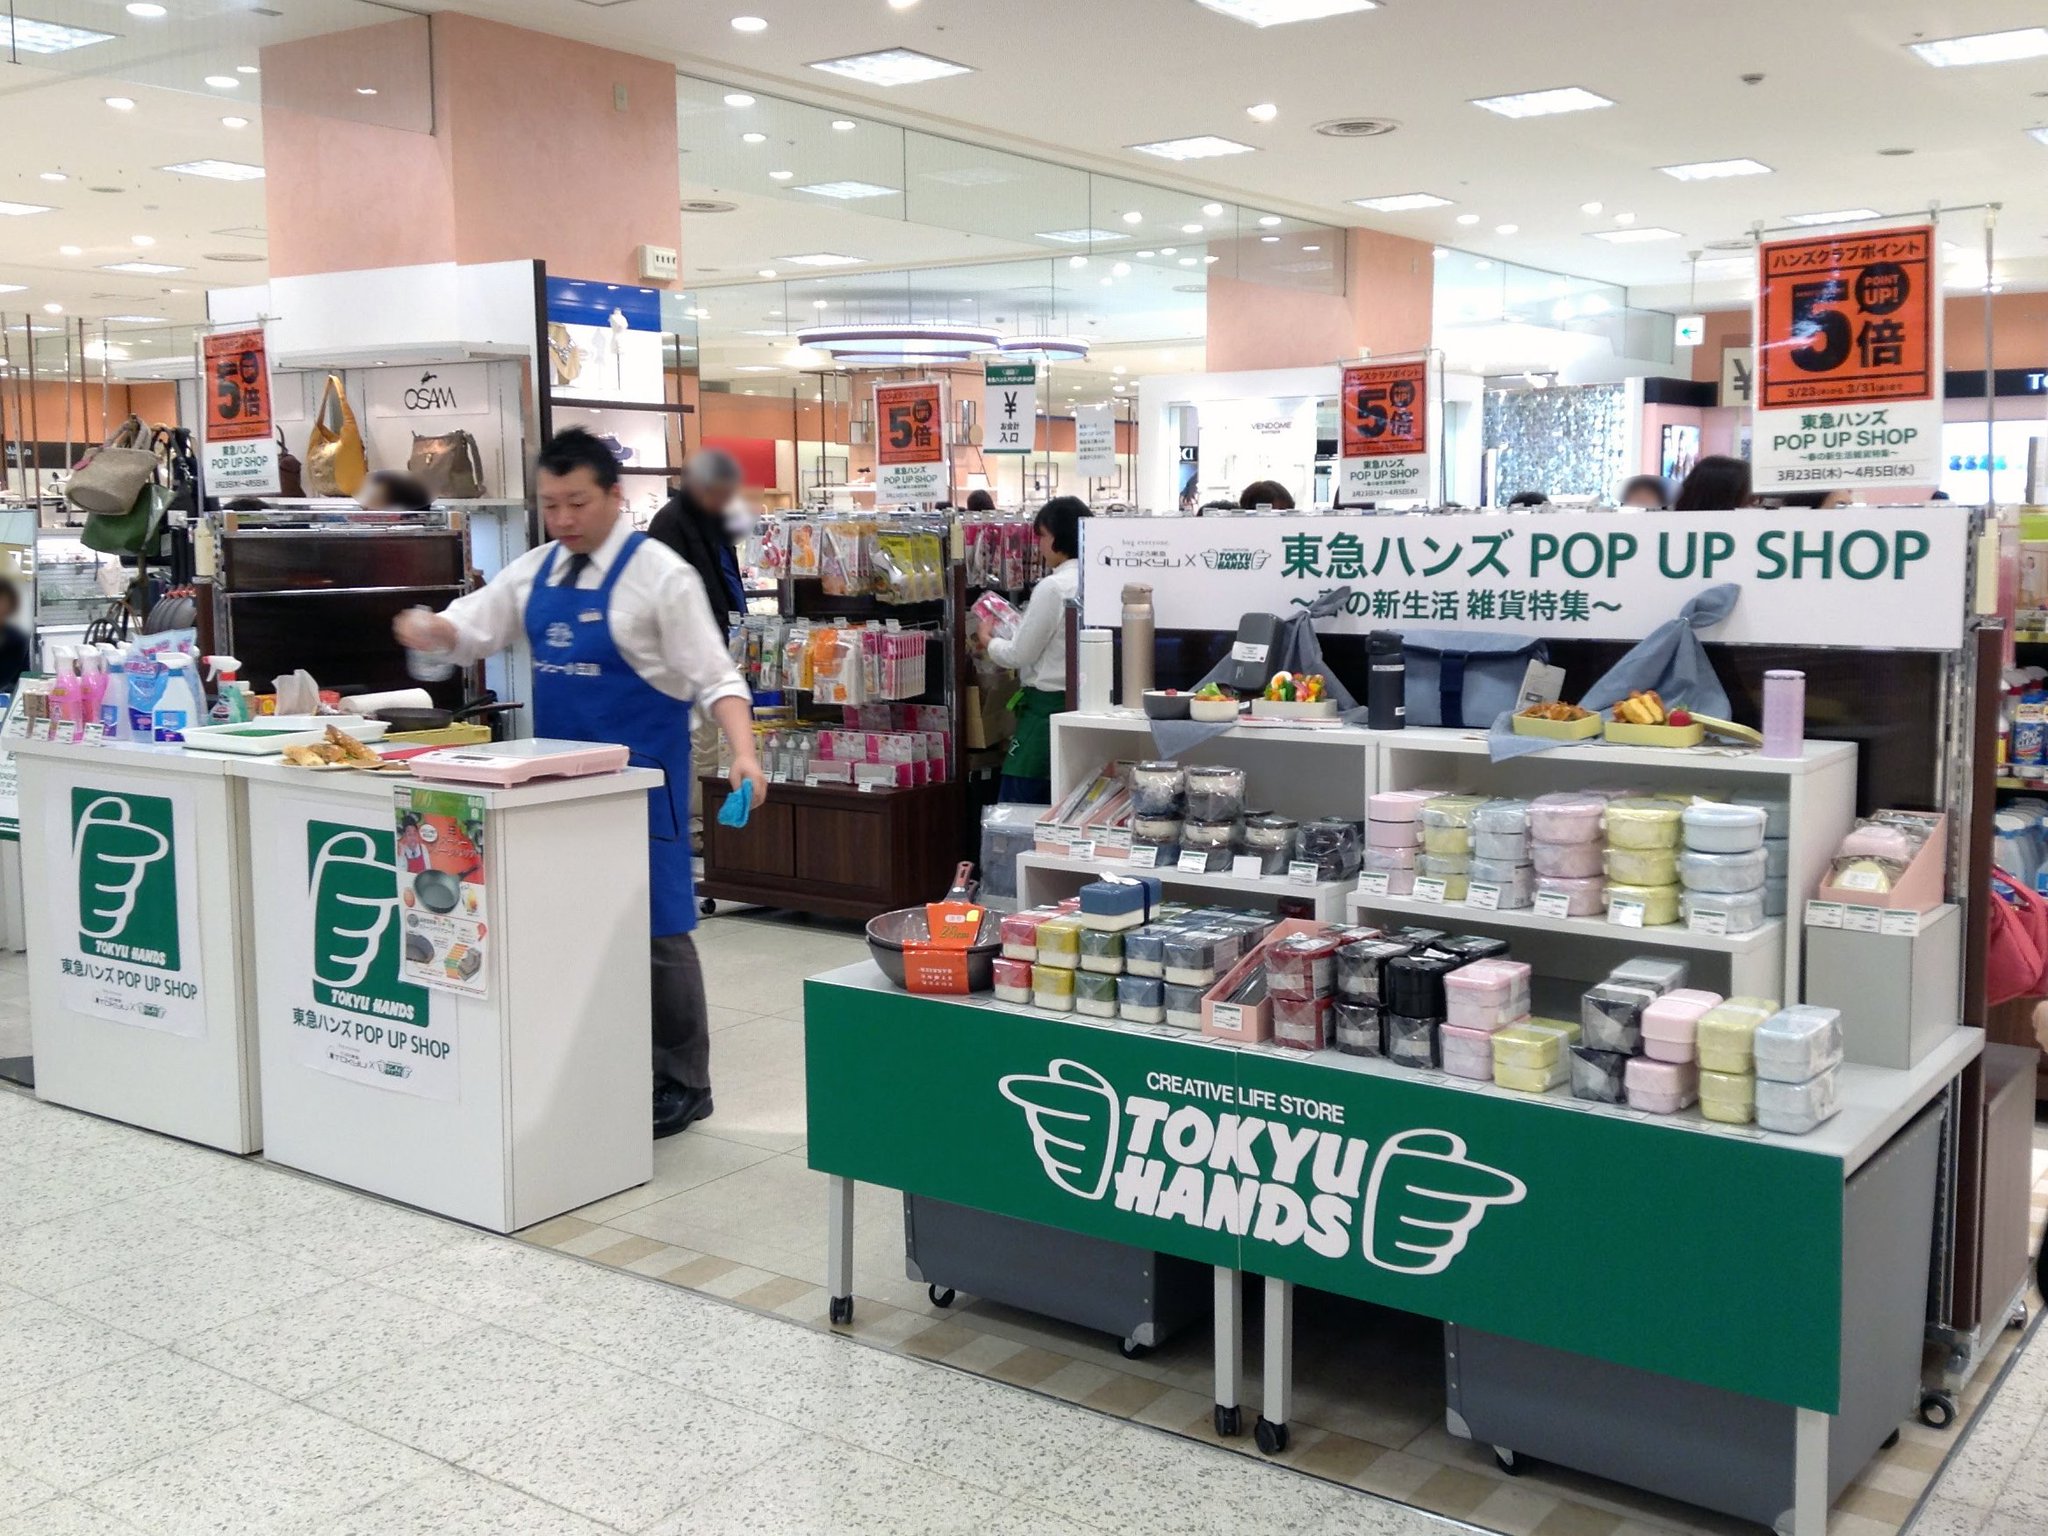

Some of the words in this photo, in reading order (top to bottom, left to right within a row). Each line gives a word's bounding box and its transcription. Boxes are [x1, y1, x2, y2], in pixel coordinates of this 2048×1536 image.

[1773, 241, 1920, 268] ハンズクラブポイント
[1864, 274, 1899, 285] POINT
[1864, 288, 1899, 304] UP!
[1800, 409, 1890, 431] 東急ハンズ
[1000, 432, 1019, 443] 入口
[1774, 434, 1816, 451] POP
[1823, 431, 1852, 448] UP
[1857, 428, 1918, 447] SHOP
[211, 459, 228, 470] POP
[231, 457, 243, 468] UP
[244, 455, 269, 467] SHOP
[883, 476, 900, 485] POP
[902, 475, 914, 484] UP
[915, 474, 938, 483] SHOP
[1350, 471, 1372, 481] POP
[1374, 469, 1389, 480] UP
[1390, 468, 1420, 479] SHOP
[1217, 561, 1250, 570] HANDS
[1219, 552, 1252, 561] TOKYU
[1281, 529, 1515, 580] 東急ハンズ
[1530, 532, 1638, 579] POP
[1658, 531, 1736, 579] UP
[1756, 529, 1931, 580] SHOP
[95, 940, 130, 959] TOKYU
[131, 946, 167, 966] HANDS
[61, 958, 115, 984] 東急ハンズ
[117, 969, 142, 989] POP
[144, 975, 162, 993] UP
[164, 979, 198, 1000] SHOP
[331, 989, 371, 1011] TOKYU
[373, 998, 416, 1021] HANDS
[292, 1007, 352, 1039] 東急ハンズ
[355, 1022, 384, 1045] POP
[388, 1029, 408, 1050] UP
[411, 1035, 450, 1060] SHOP
[1146, 1072, 1234, 1104] CREATIVE
[1237, 1088, 1276, 1111] LIFE
[1280, 1095, 1345, 1125] STORE
[1125, 1095, 1369, 1199] TOKYU
[1114, 1154, 1352, 1259] HANDS
